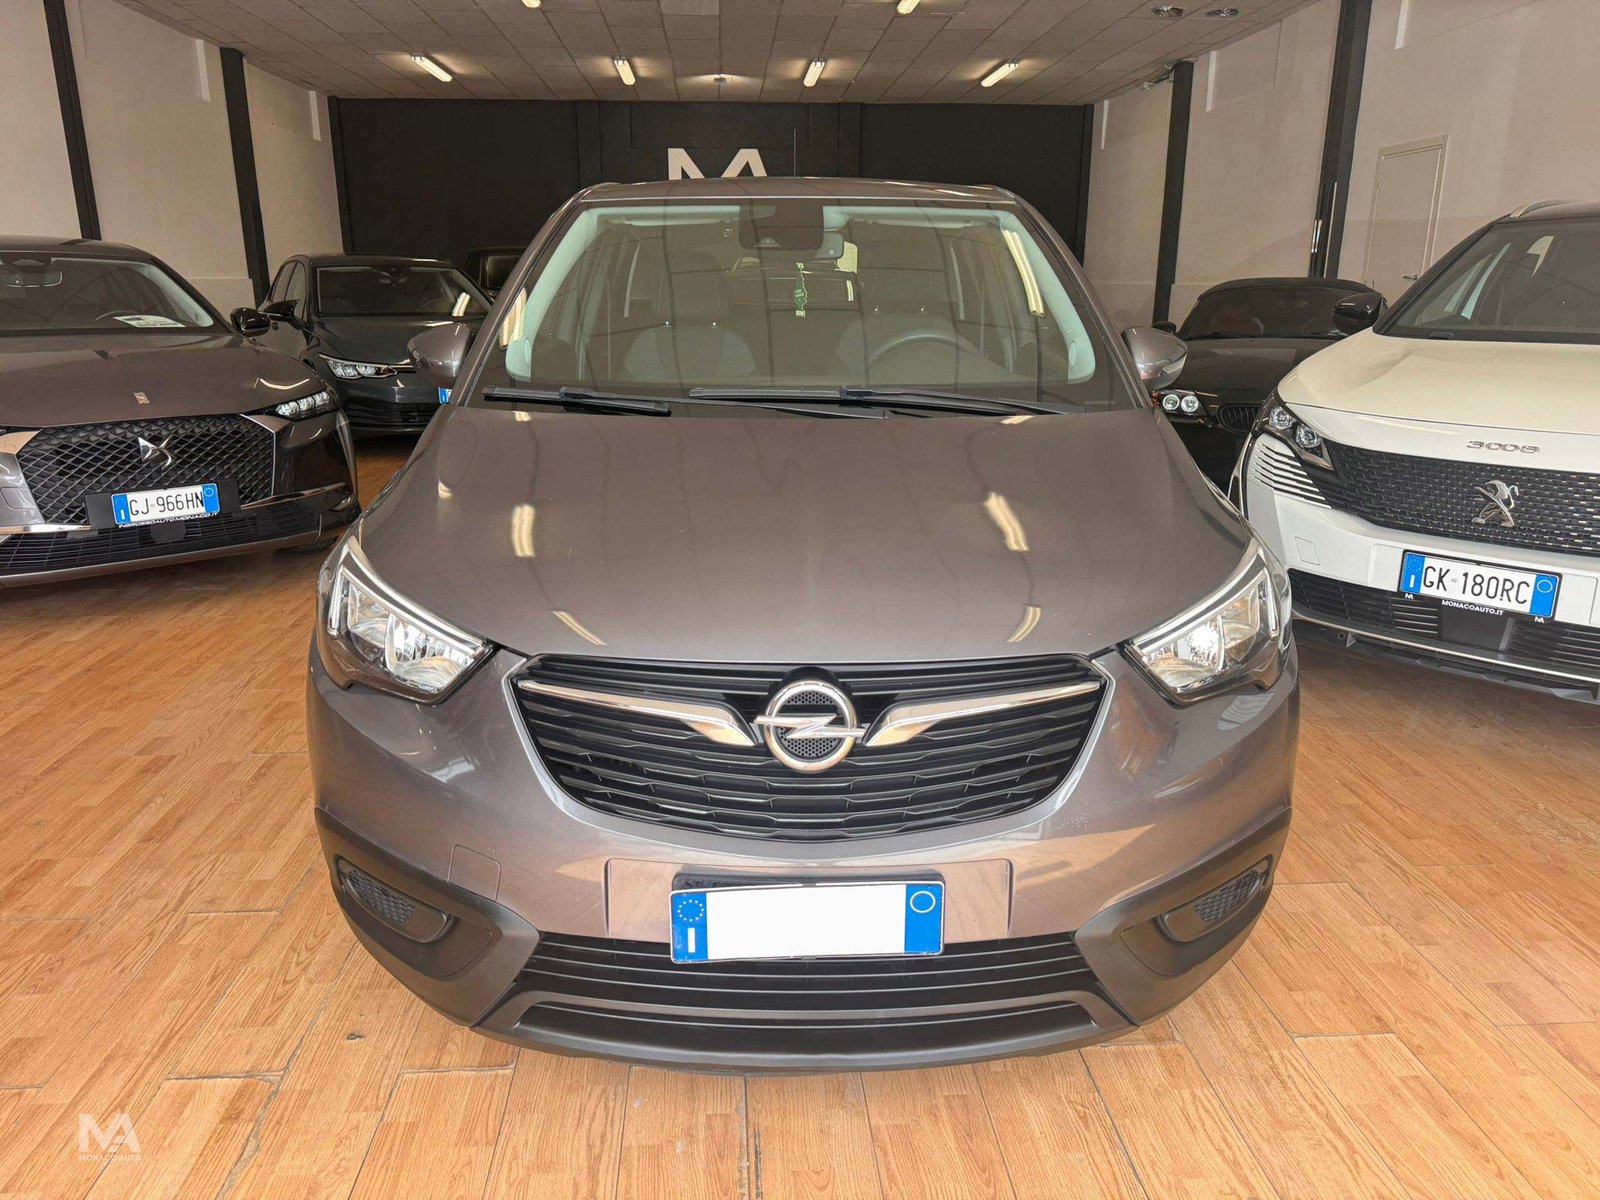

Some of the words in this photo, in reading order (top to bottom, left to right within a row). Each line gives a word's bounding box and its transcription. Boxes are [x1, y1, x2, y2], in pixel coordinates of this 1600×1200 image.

[1466, 440, 1540, 454] 3008
[129, 497, 150, 516] GJ
[156, 491, 205, 514] 966HN
[1423, 565, 1451, 592] GK
[1461, 571, 1530, 605] 180RC
[1441, 599, 1504, 616] MONACOAUTO.IT
